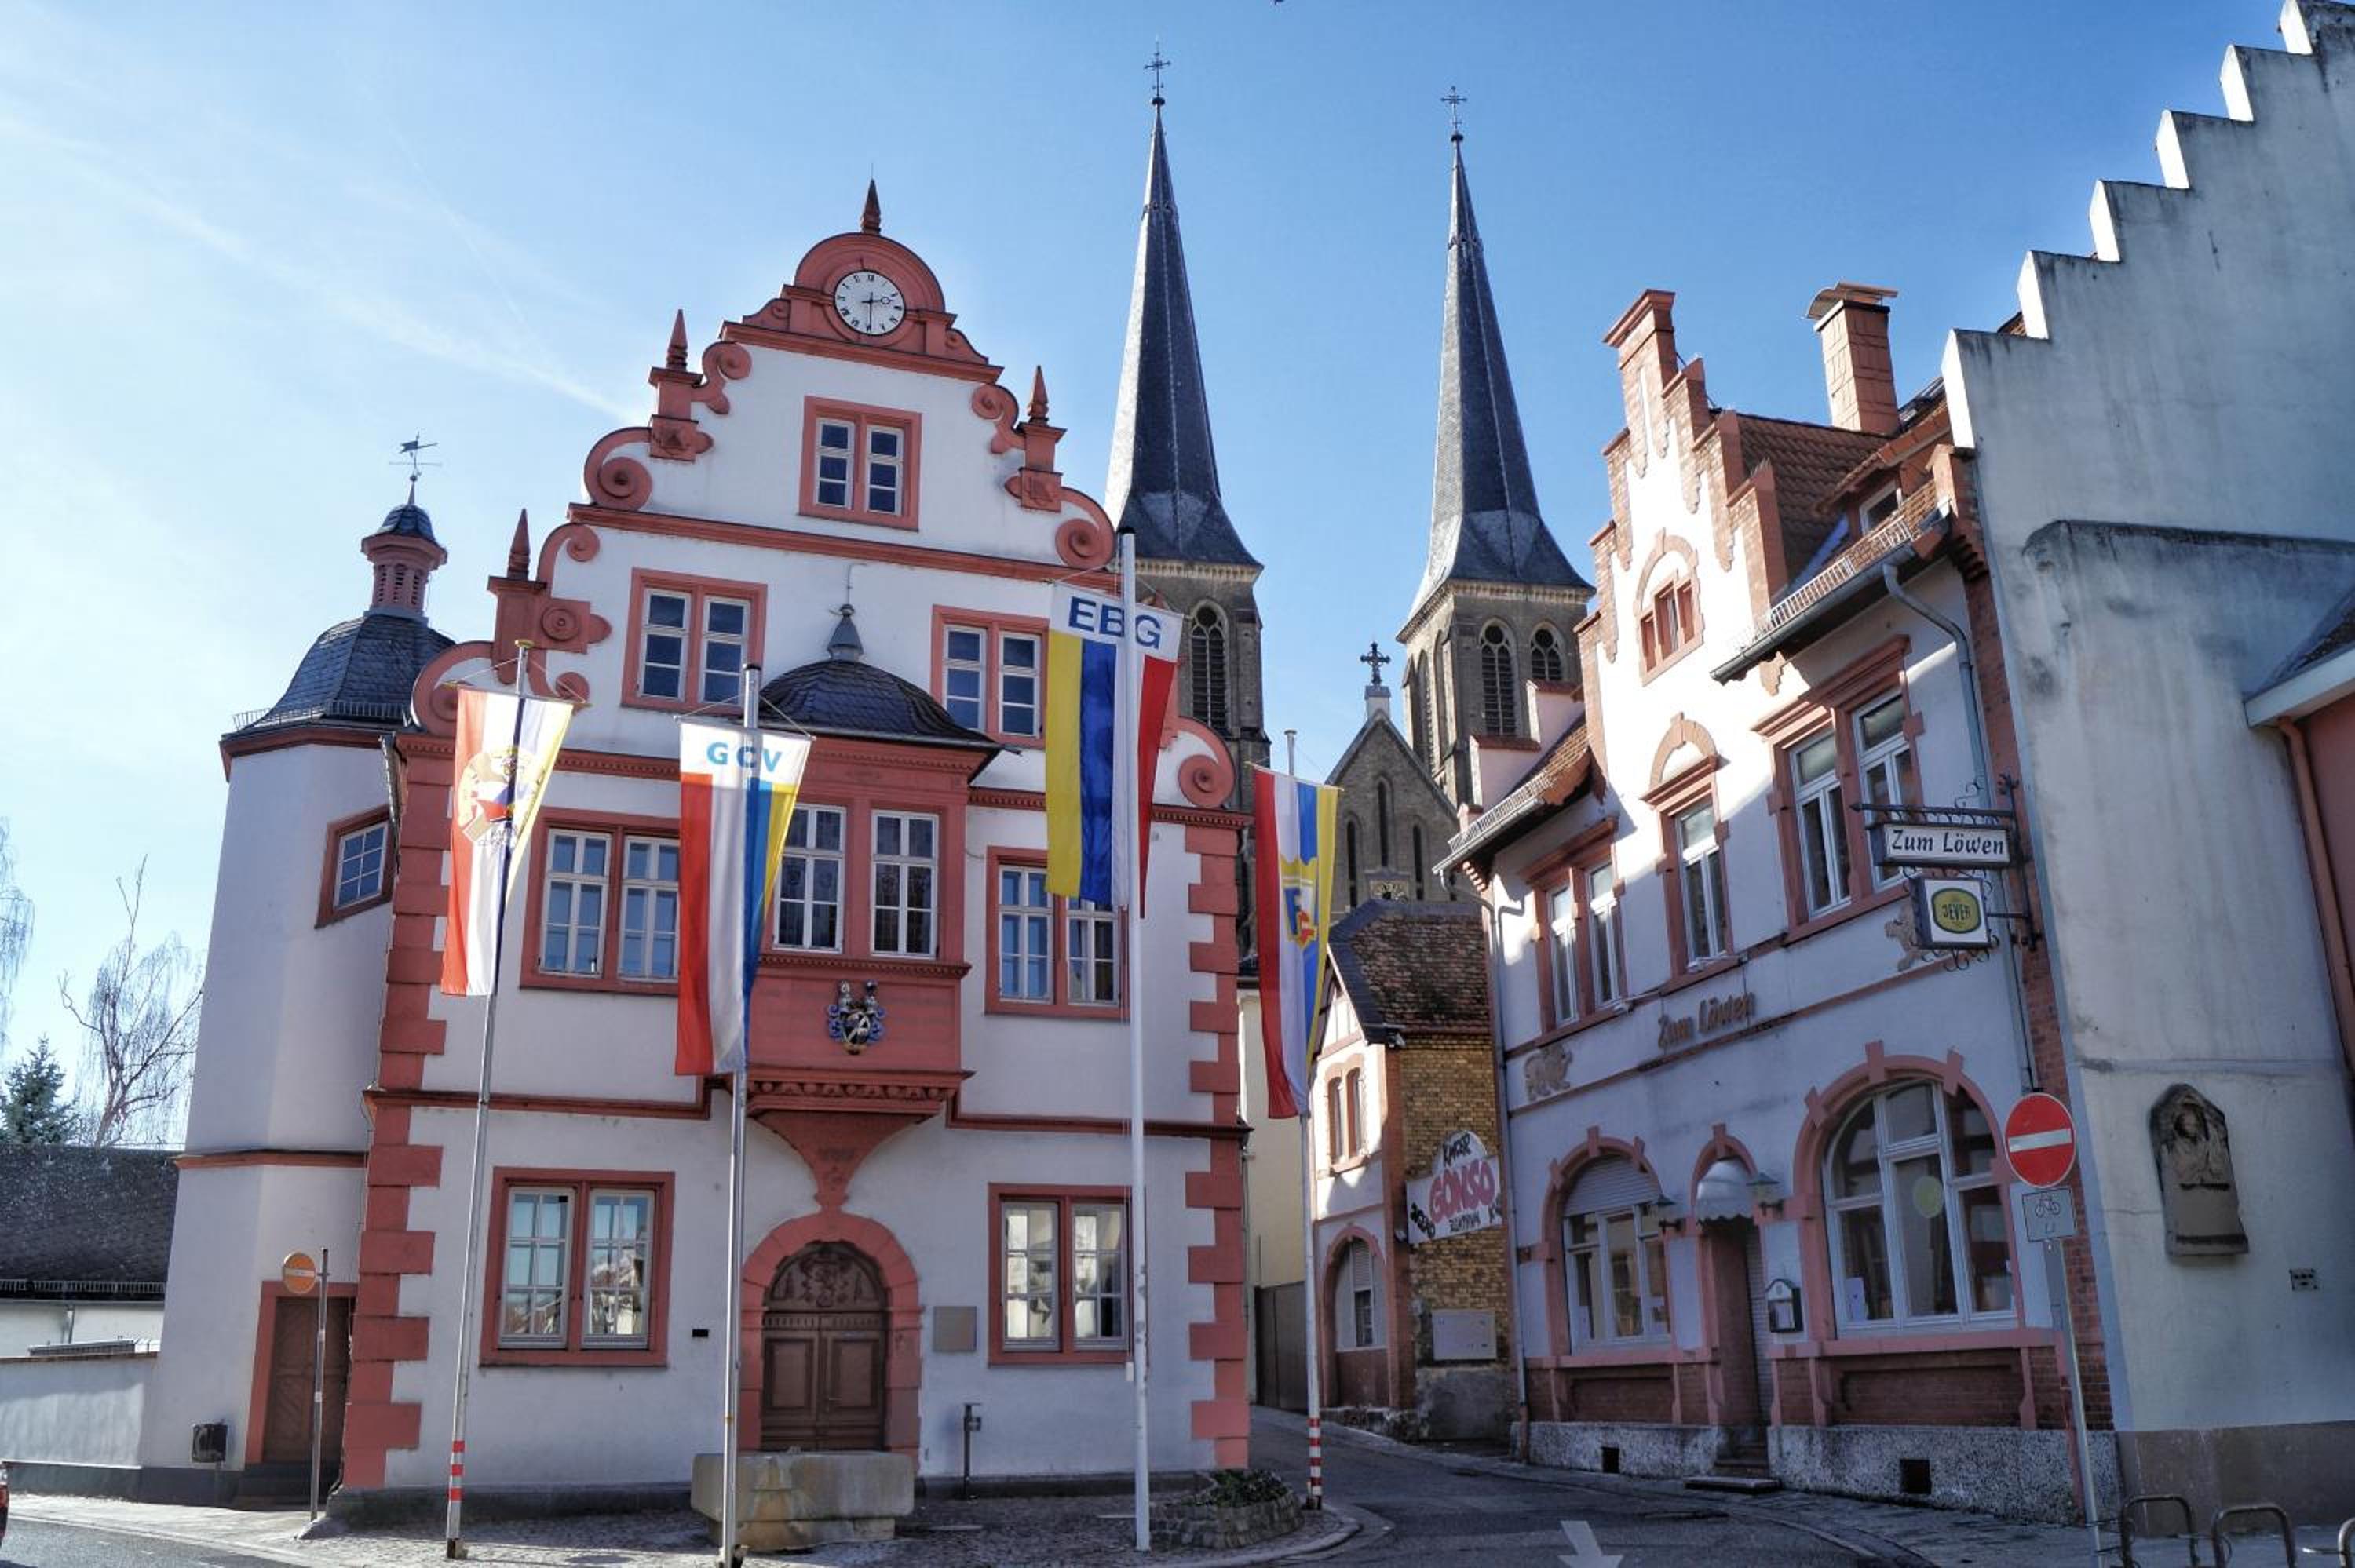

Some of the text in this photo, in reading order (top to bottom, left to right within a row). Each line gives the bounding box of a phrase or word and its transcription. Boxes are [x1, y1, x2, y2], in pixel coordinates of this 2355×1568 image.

[1068, 596, 1161, 650] EBG
[706, 741, 783, 773] GCV
[1892, 830, 2004, 855] Zum Löwen
